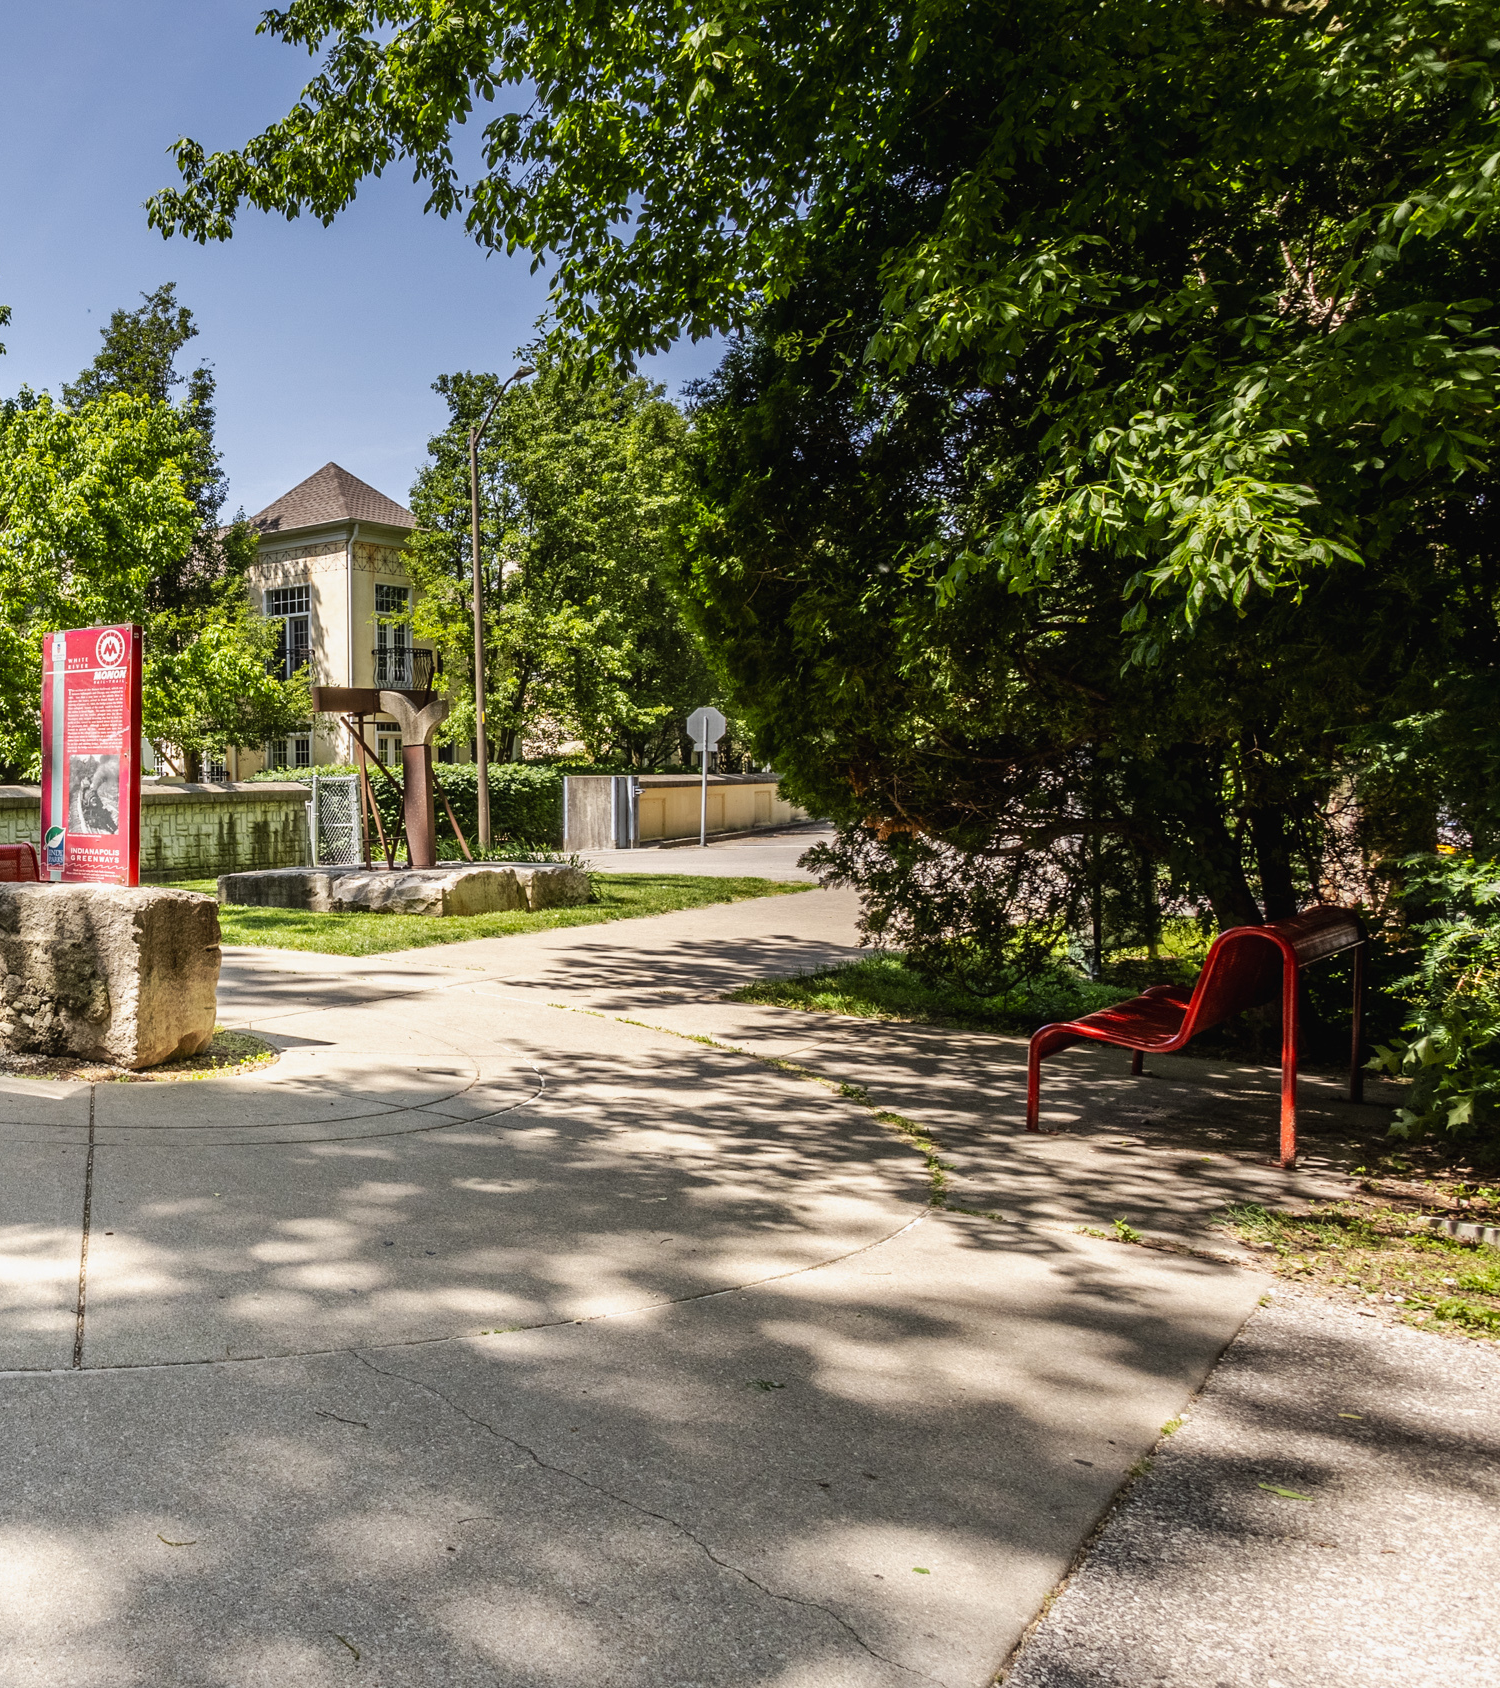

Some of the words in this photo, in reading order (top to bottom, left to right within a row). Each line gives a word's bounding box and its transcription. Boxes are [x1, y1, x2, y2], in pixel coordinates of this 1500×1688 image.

[93, 670, 126, 680] MONON
[70, 847, 120, 857] INDIANAPOLIS
[70, 854, 120, 864] GREENWAYS
